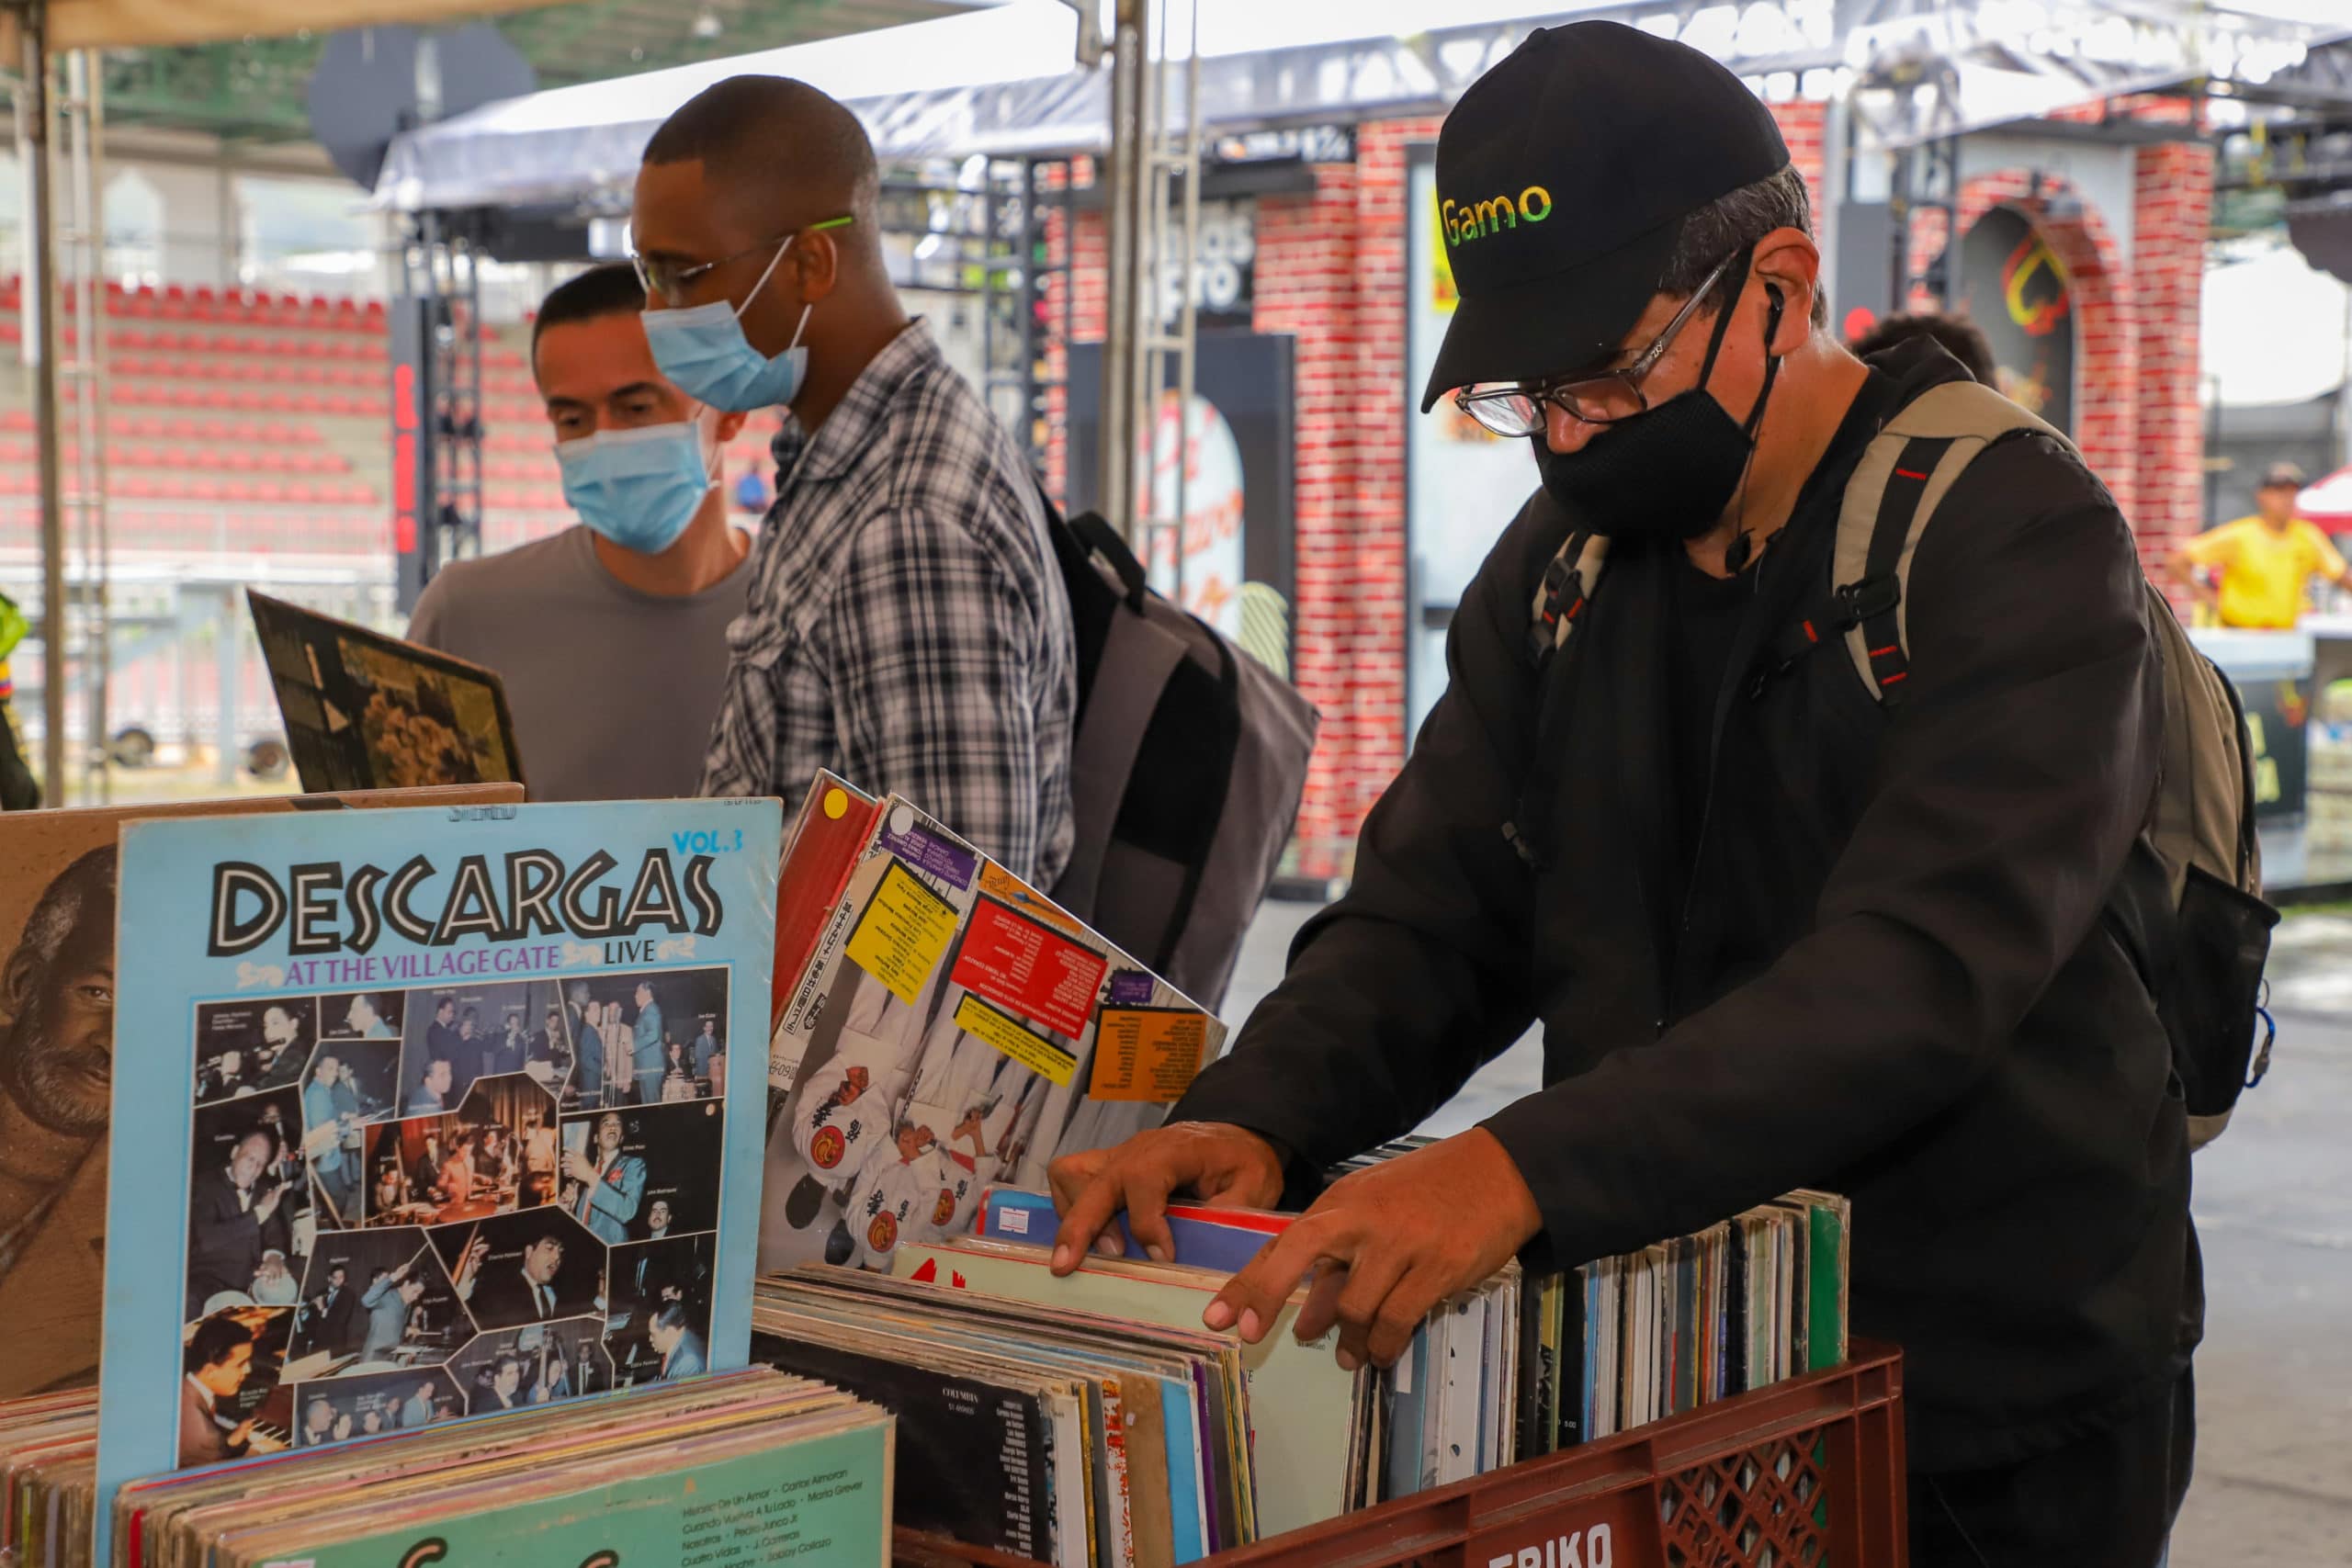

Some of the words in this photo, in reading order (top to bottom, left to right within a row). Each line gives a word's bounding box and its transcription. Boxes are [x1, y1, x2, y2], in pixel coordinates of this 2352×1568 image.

[1442, 186, 1552, 246] Gamo
[208, 848, 723, 957] DESCARGAS
[284, 961, 322, 987] AT
[324, 957, 378, 984] THE
[381, 950, 491, 980] VILLAGE
[493, 945, 560, 972] GATE
[605, 940, 655, 964] LIVE
[746, 1489, 770, 1504] Amor
[683, 1518, 721, 1535] Cuando
[1488, 1523, 1613, 1568] IKO
